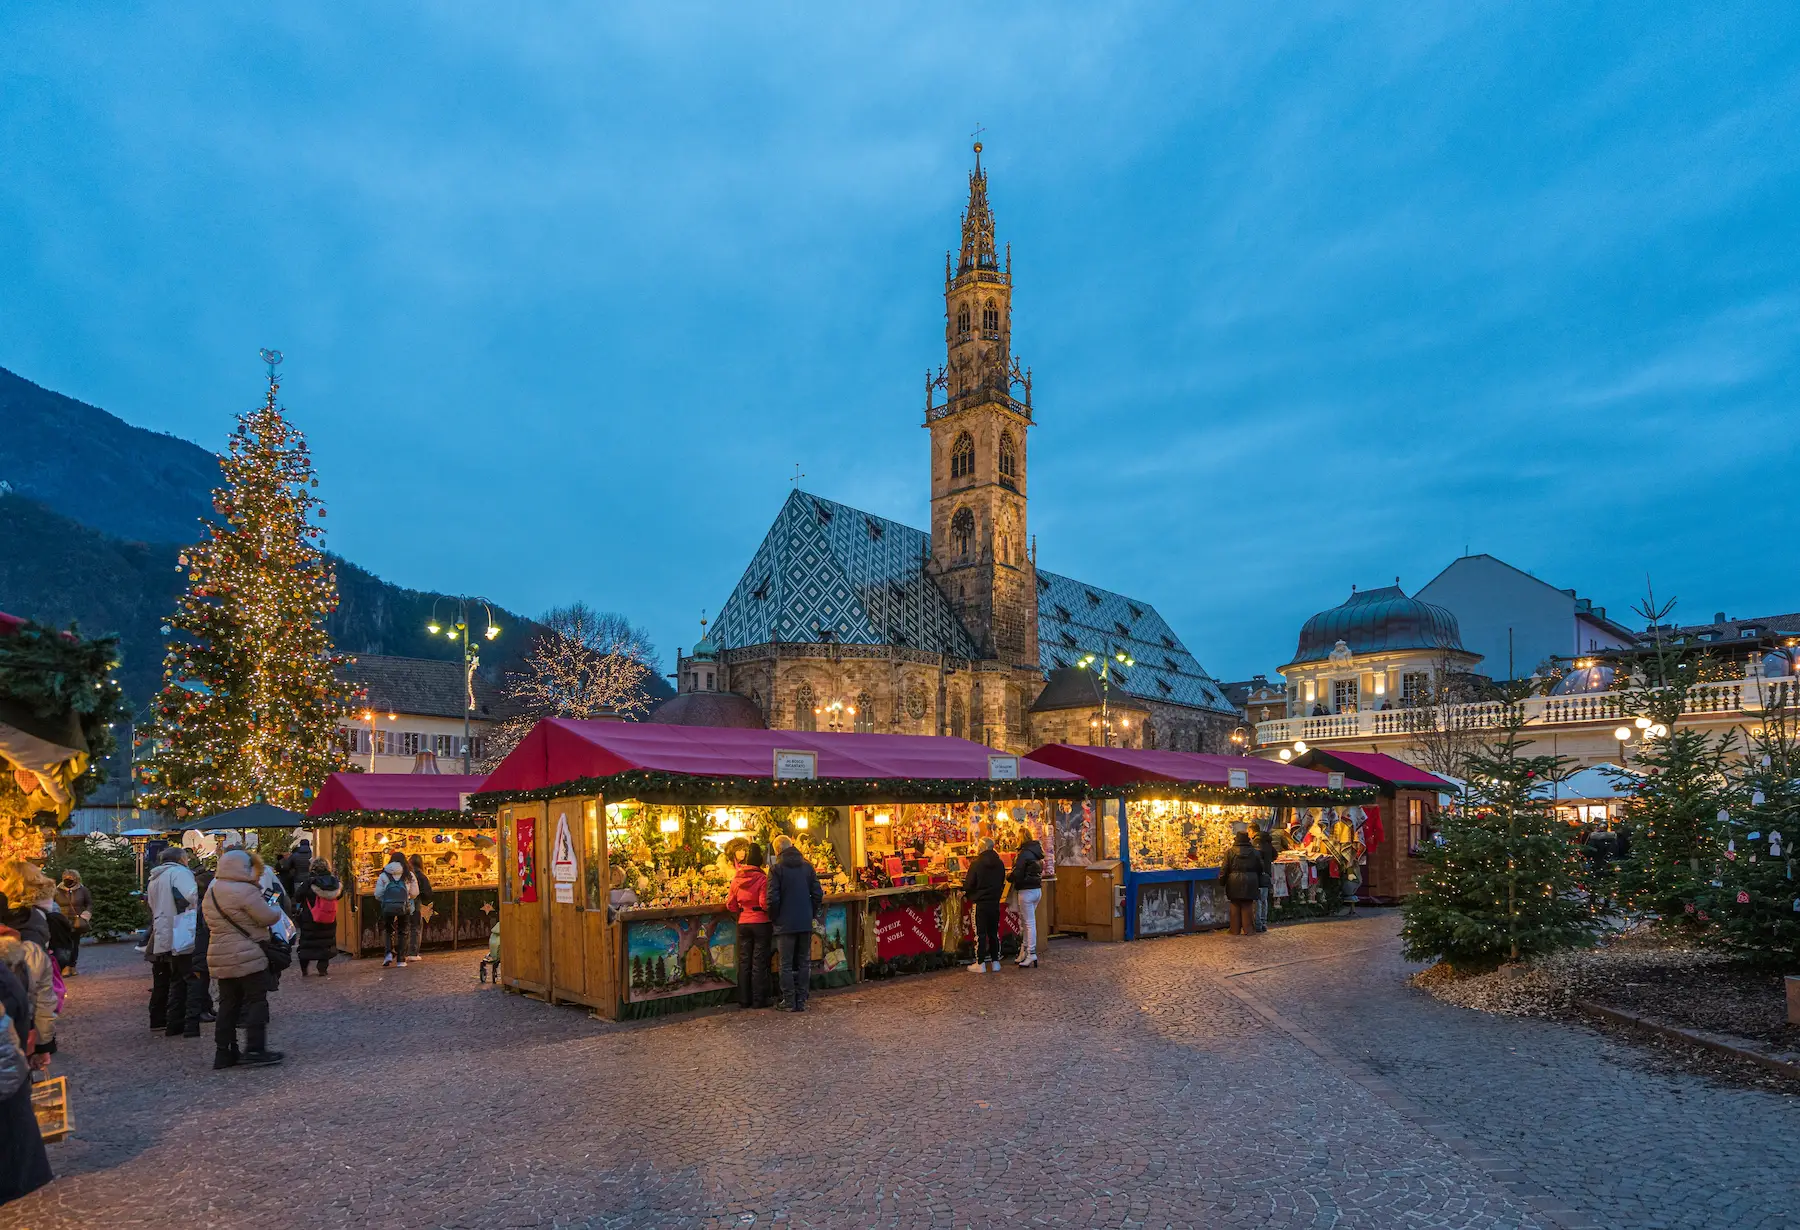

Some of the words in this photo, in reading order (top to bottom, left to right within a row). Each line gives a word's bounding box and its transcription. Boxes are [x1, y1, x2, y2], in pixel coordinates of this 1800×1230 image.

[905, 907, 922, 924] FELIZ
[886, 931, 904, 943] NOEL
[912, 926, 934, 948] NAVIDAD
